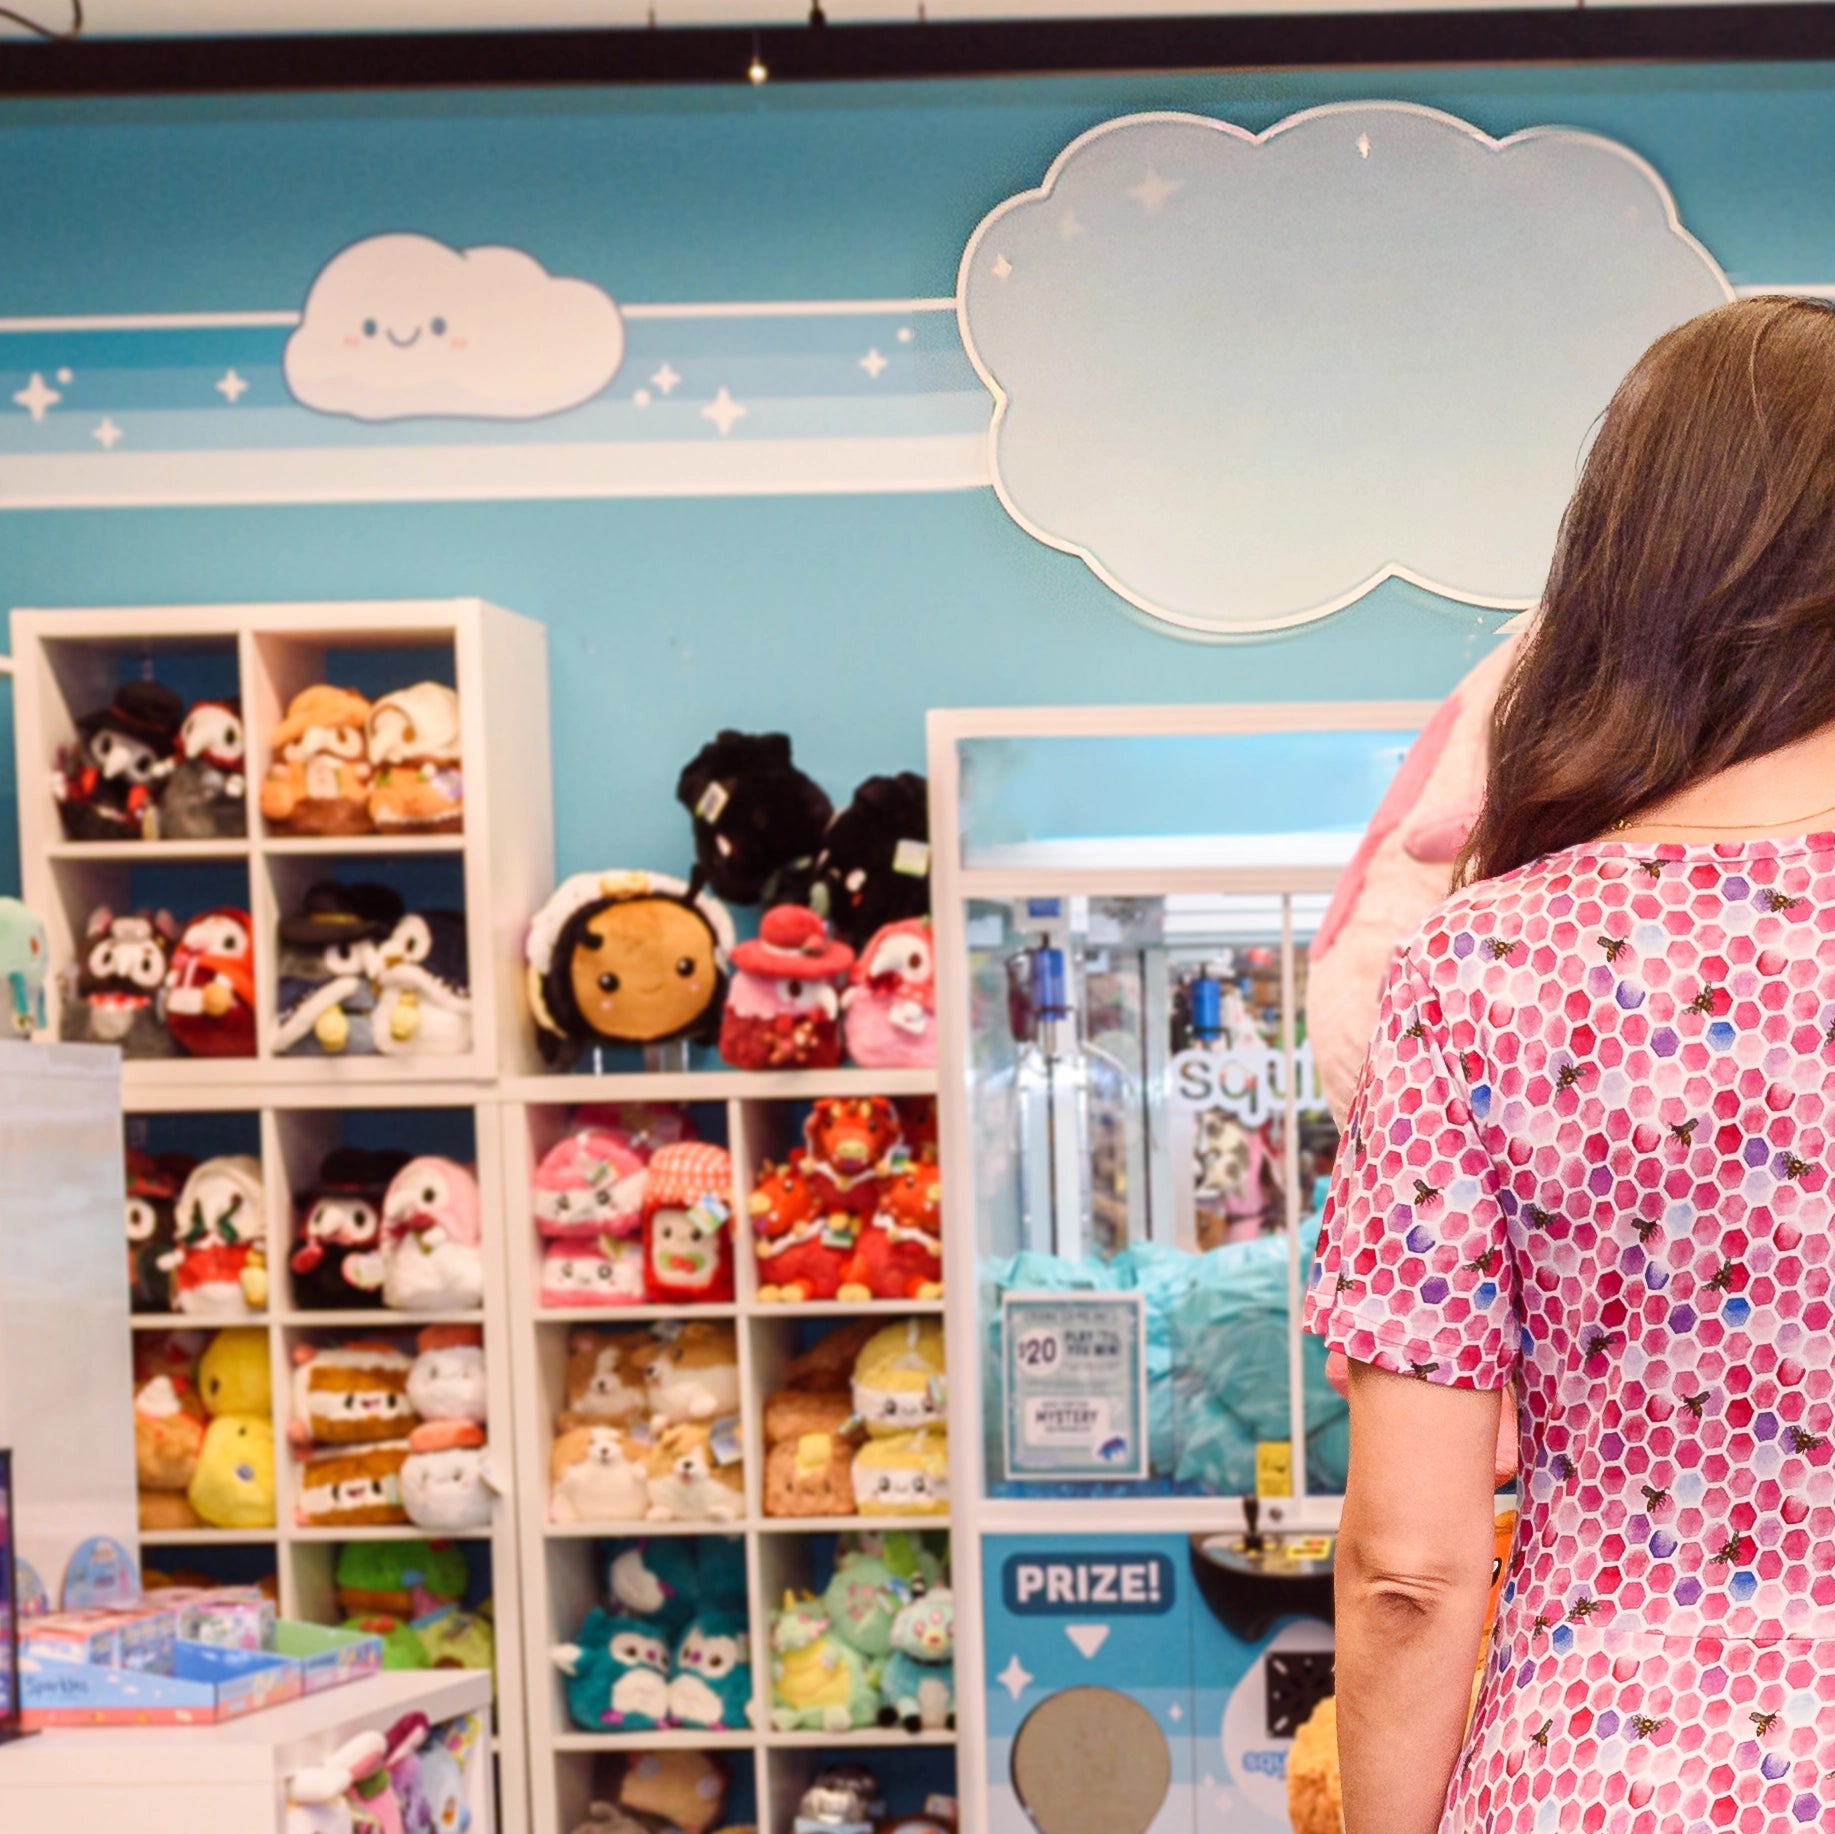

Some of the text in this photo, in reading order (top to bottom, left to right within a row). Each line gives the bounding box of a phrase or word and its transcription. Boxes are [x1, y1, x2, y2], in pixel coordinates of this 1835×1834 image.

[1017, 1336, 1058, 1365] $20
[1035, 1410, 1099, 1424] MYSTERY
[1016, 1561, 1161, 1604] PRIZE!
